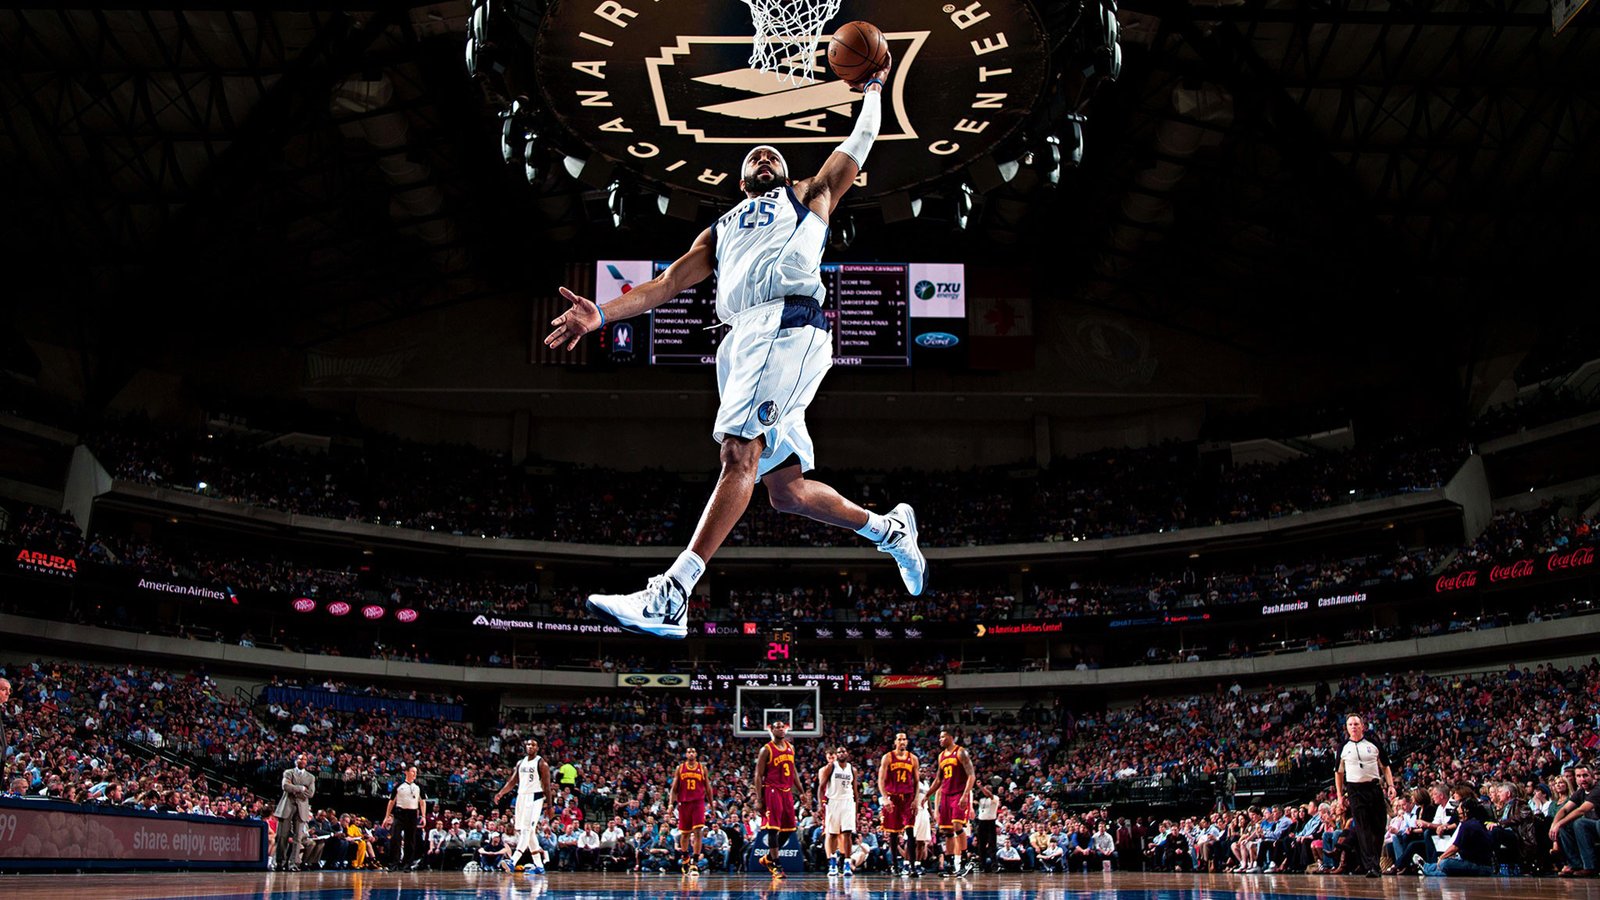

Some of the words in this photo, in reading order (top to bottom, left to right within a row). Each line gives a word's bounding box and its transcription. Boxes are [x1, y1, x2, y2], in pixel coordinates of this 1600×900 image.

[928, 1, 1013, 156] CENTER
[739, 201, 776, 229] 25
[936, 283, 961, 293] TXU
[923, 334, 950, 346] Ford
[16, 549, 78, 573] ARUBA
[18, 564, 74, 578] networks
[138, 578, 187, 594] American
[187, 586, 225, 600] Airlines
[490, 618, 534, 628] Albertsons
[544, 622, 572, 630] means
[580, 625, 601, 633] great
[995, 624, 1020, 634] American
[767, 642, 789, 660] 24
[783, 762, 791, 777] 3
[896, 770, 907, 784] 14
[687, 779, 696, 790] 13
[133, 827, 170, 850] share.
[172, 830, 206, 856] enjoy.
[209, 834, 242, 856] repeat.
[754, 848, 798, 857] SOUWEST
